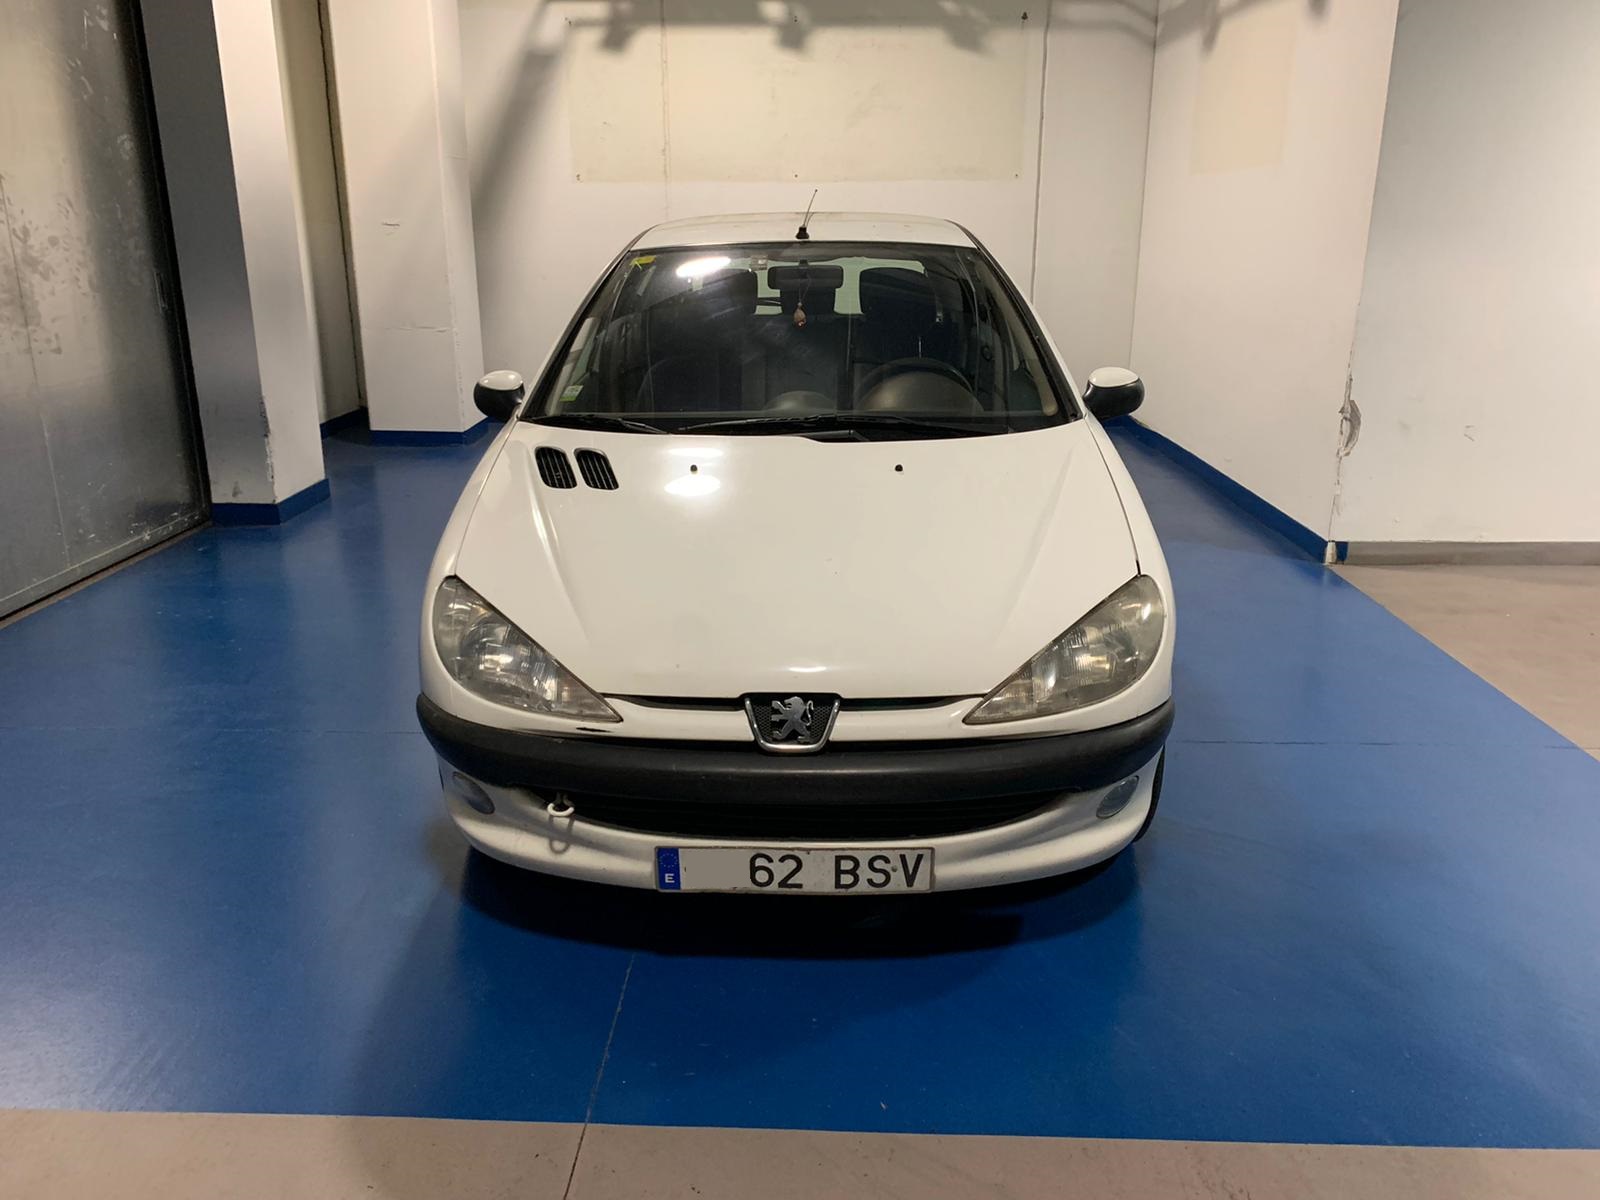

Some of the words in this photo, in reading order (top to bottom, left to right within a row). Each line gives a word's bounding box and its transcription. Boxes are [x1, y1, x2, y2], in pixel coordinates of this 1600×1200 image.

[664, 873, 675, 883] E
[750, 853, 804, 888] 62
[834, 854, 924, 889] BSV
